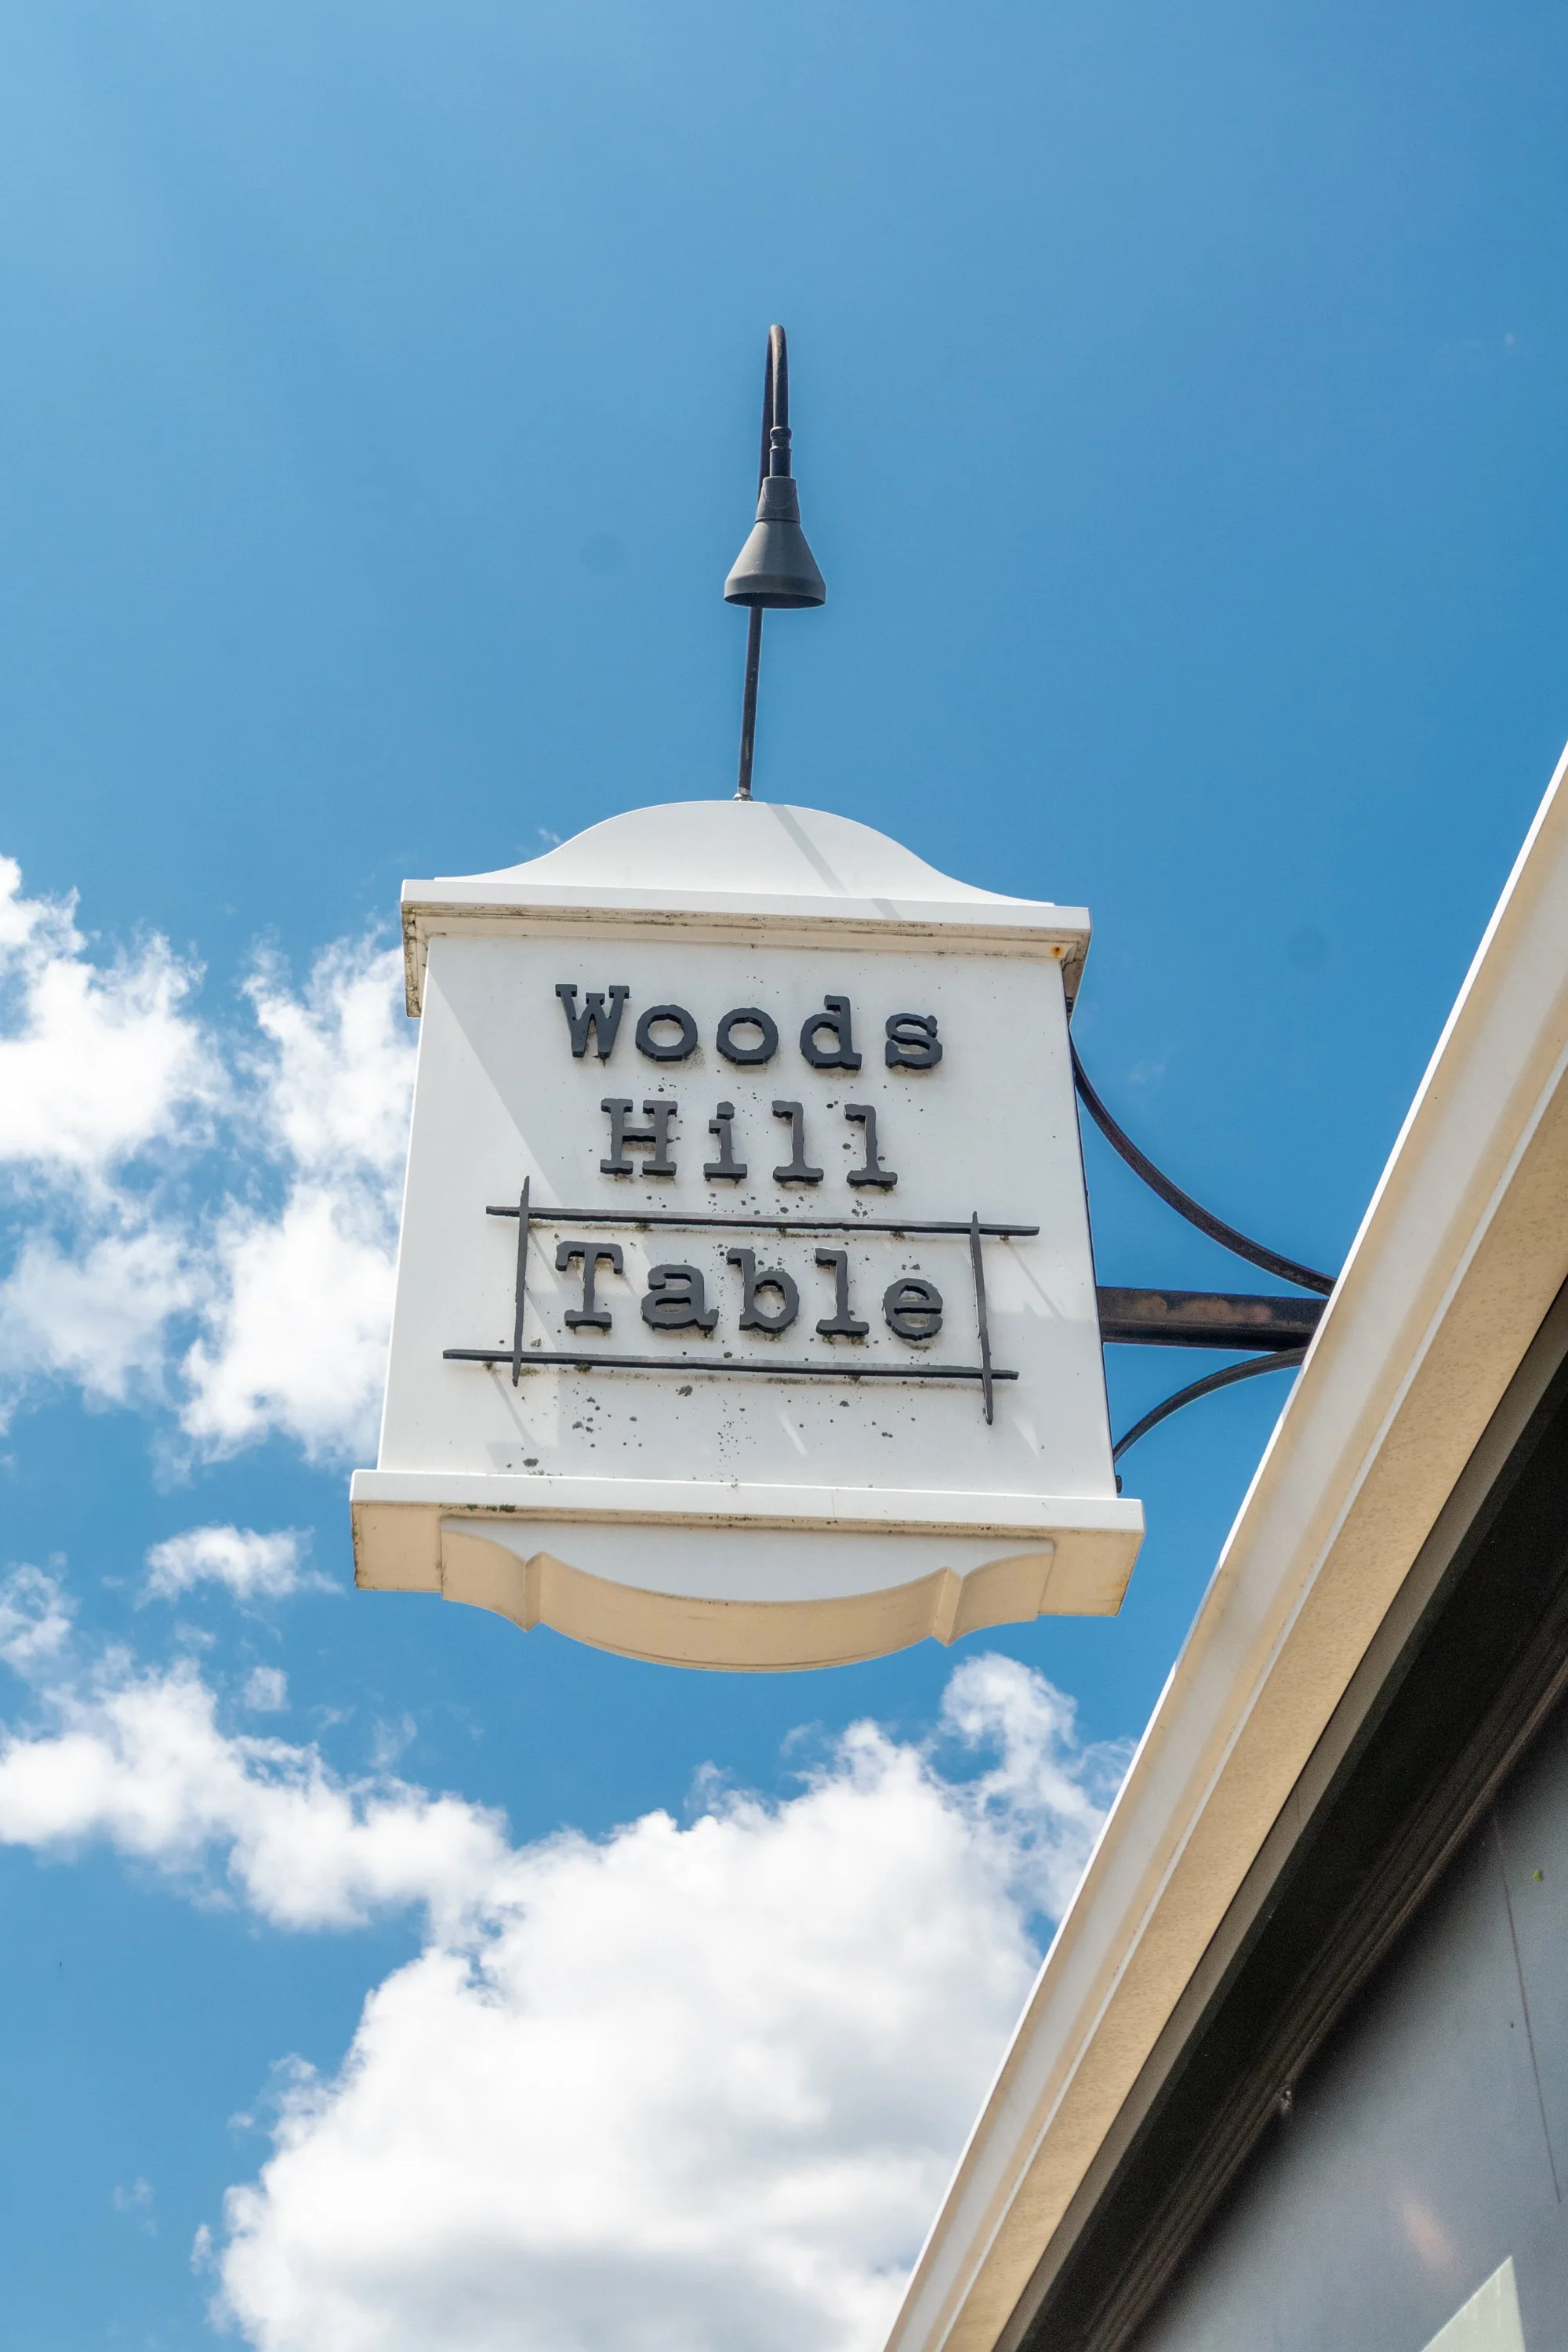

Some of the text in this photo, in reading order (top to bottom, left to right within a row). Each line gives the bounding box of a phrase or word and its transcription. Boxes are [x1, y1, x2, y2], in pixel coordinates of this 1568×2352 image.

[554, 983, 943, 1072] Woods
[600, 1098, 898, 1189] Hill
[554, 1240, 944, 1341] Table
